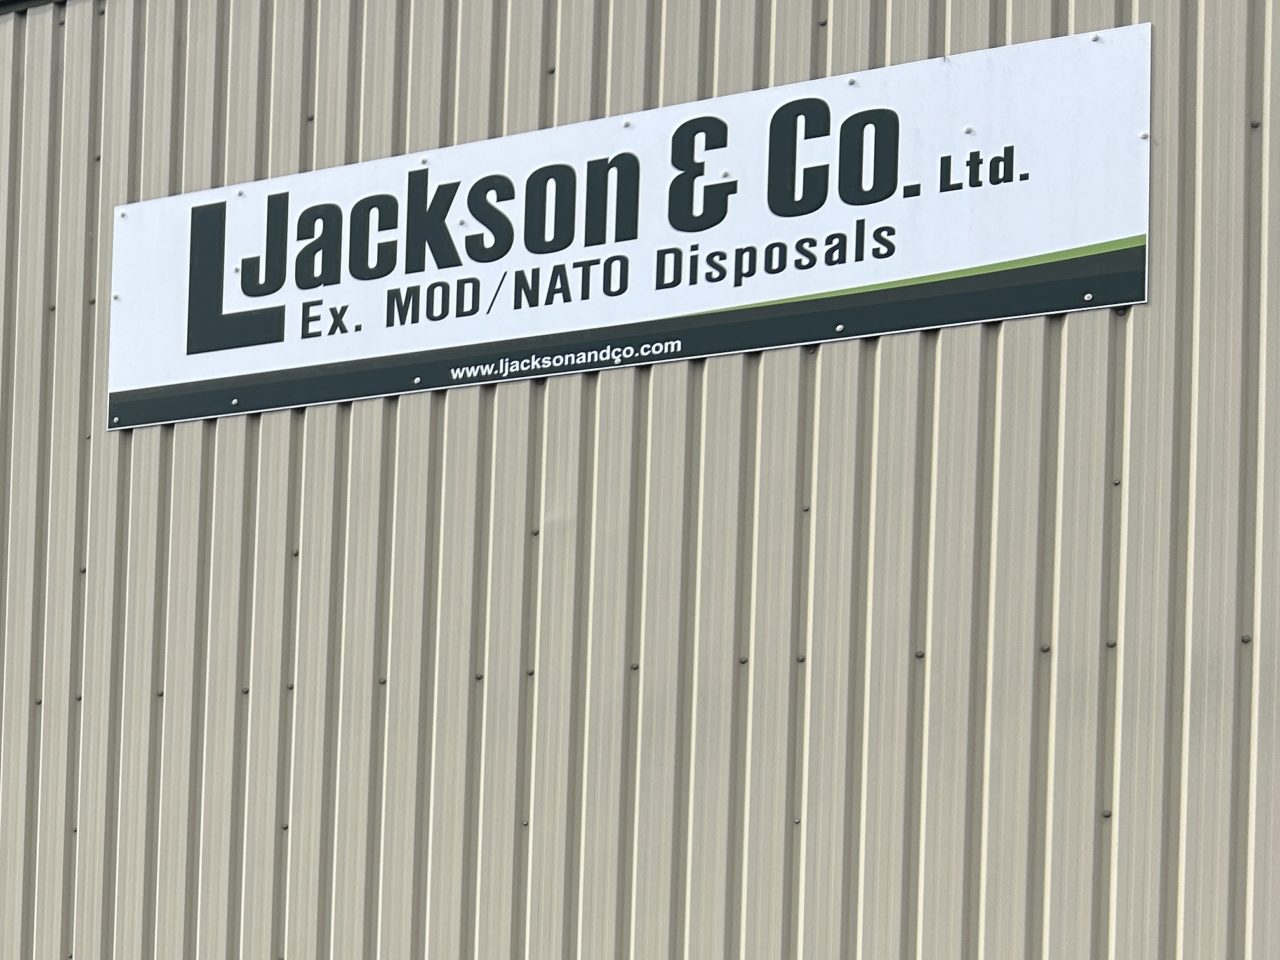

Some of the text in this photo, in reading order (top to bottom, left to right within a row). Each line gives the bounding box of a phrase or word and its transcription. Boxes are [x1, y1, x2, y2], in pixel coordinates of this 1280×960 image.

[668, 115, 738, 233] &
[767, 97, 922, 218] Co.
[939, 145, 1030, 193] Ltd.
[300, 218, 897, 340] Ex. MOD/NATO Disposals
[450, 339, 682, 380] www.ljacksonandco.com
